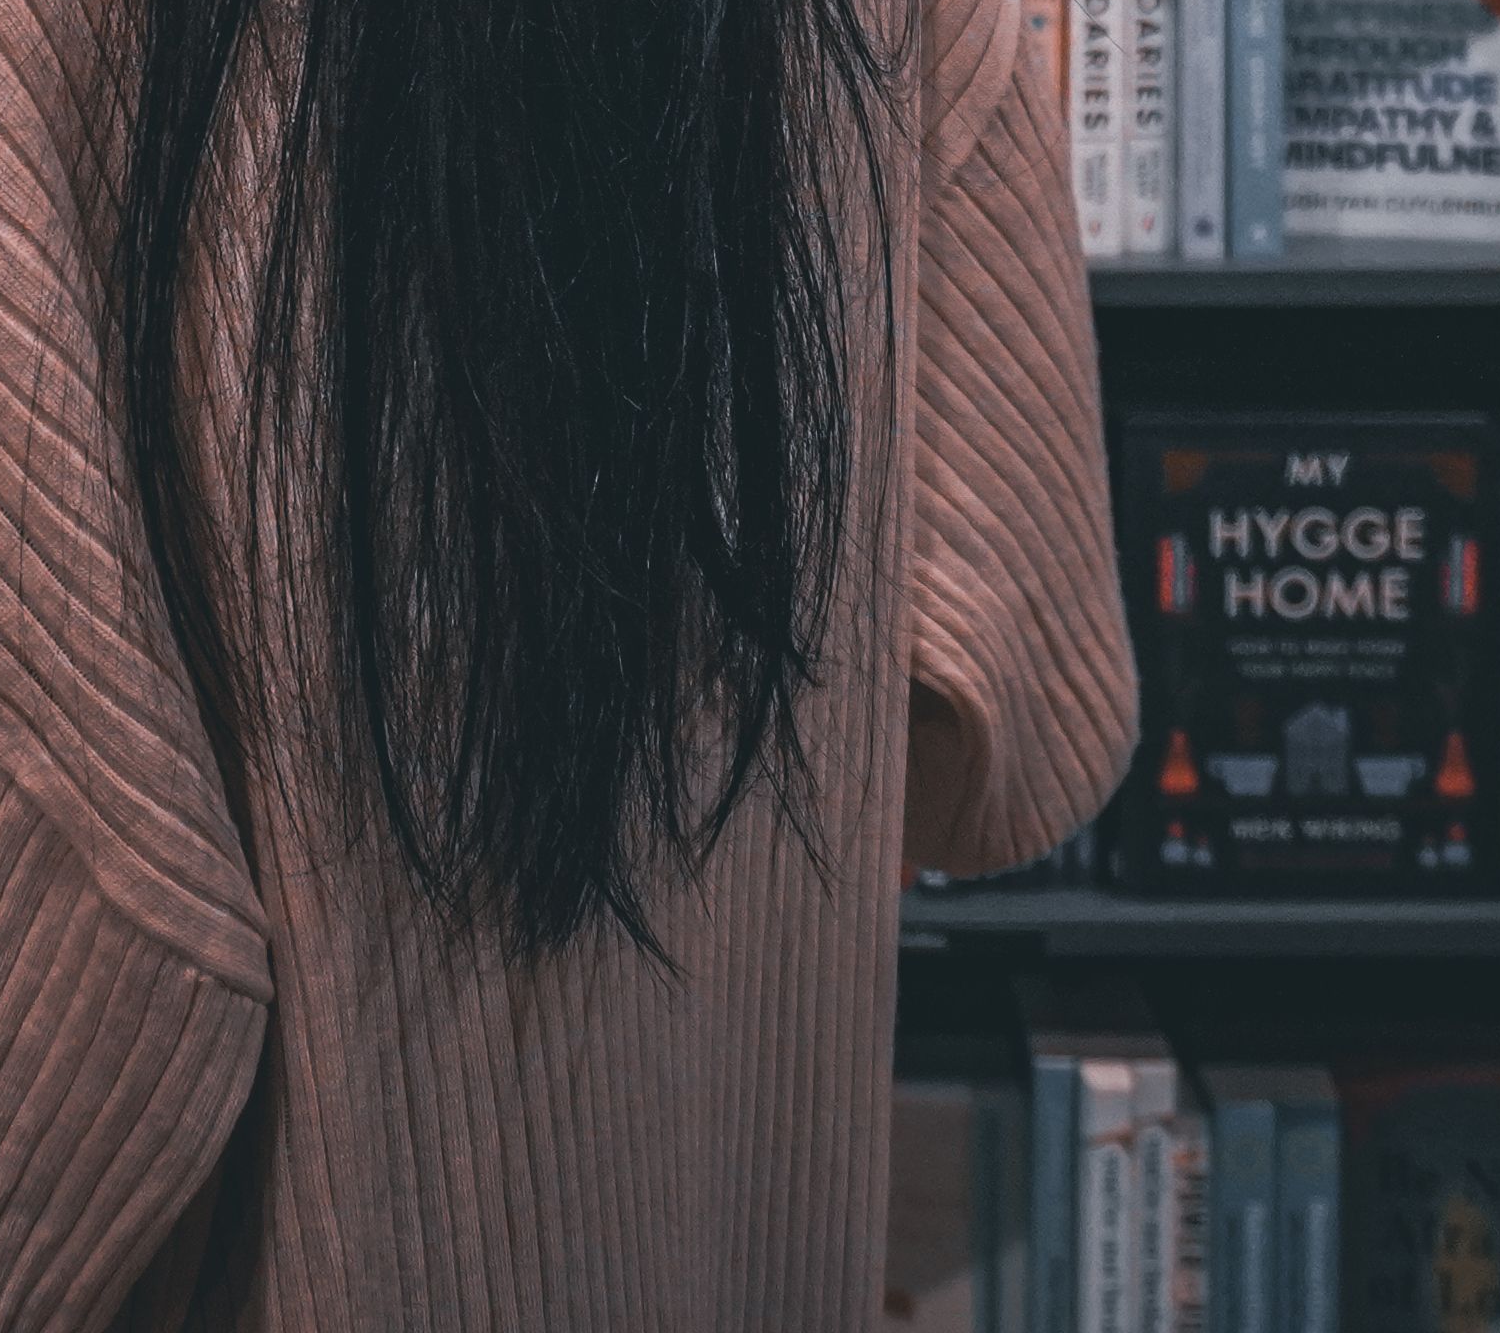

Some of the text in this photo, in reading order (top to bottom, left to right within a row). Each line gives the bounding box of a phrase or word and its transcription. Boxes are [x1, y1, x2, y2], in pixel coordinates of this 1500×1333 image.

[1472, 112, 1495, 137] &
[1286, 454, 1351, 486] MY
[1208, 508, 1427, 561] HYGGE
[1224, 566, 1412, 620] HOME
[1231, 817, 1401, 840] MEIK WIKING
